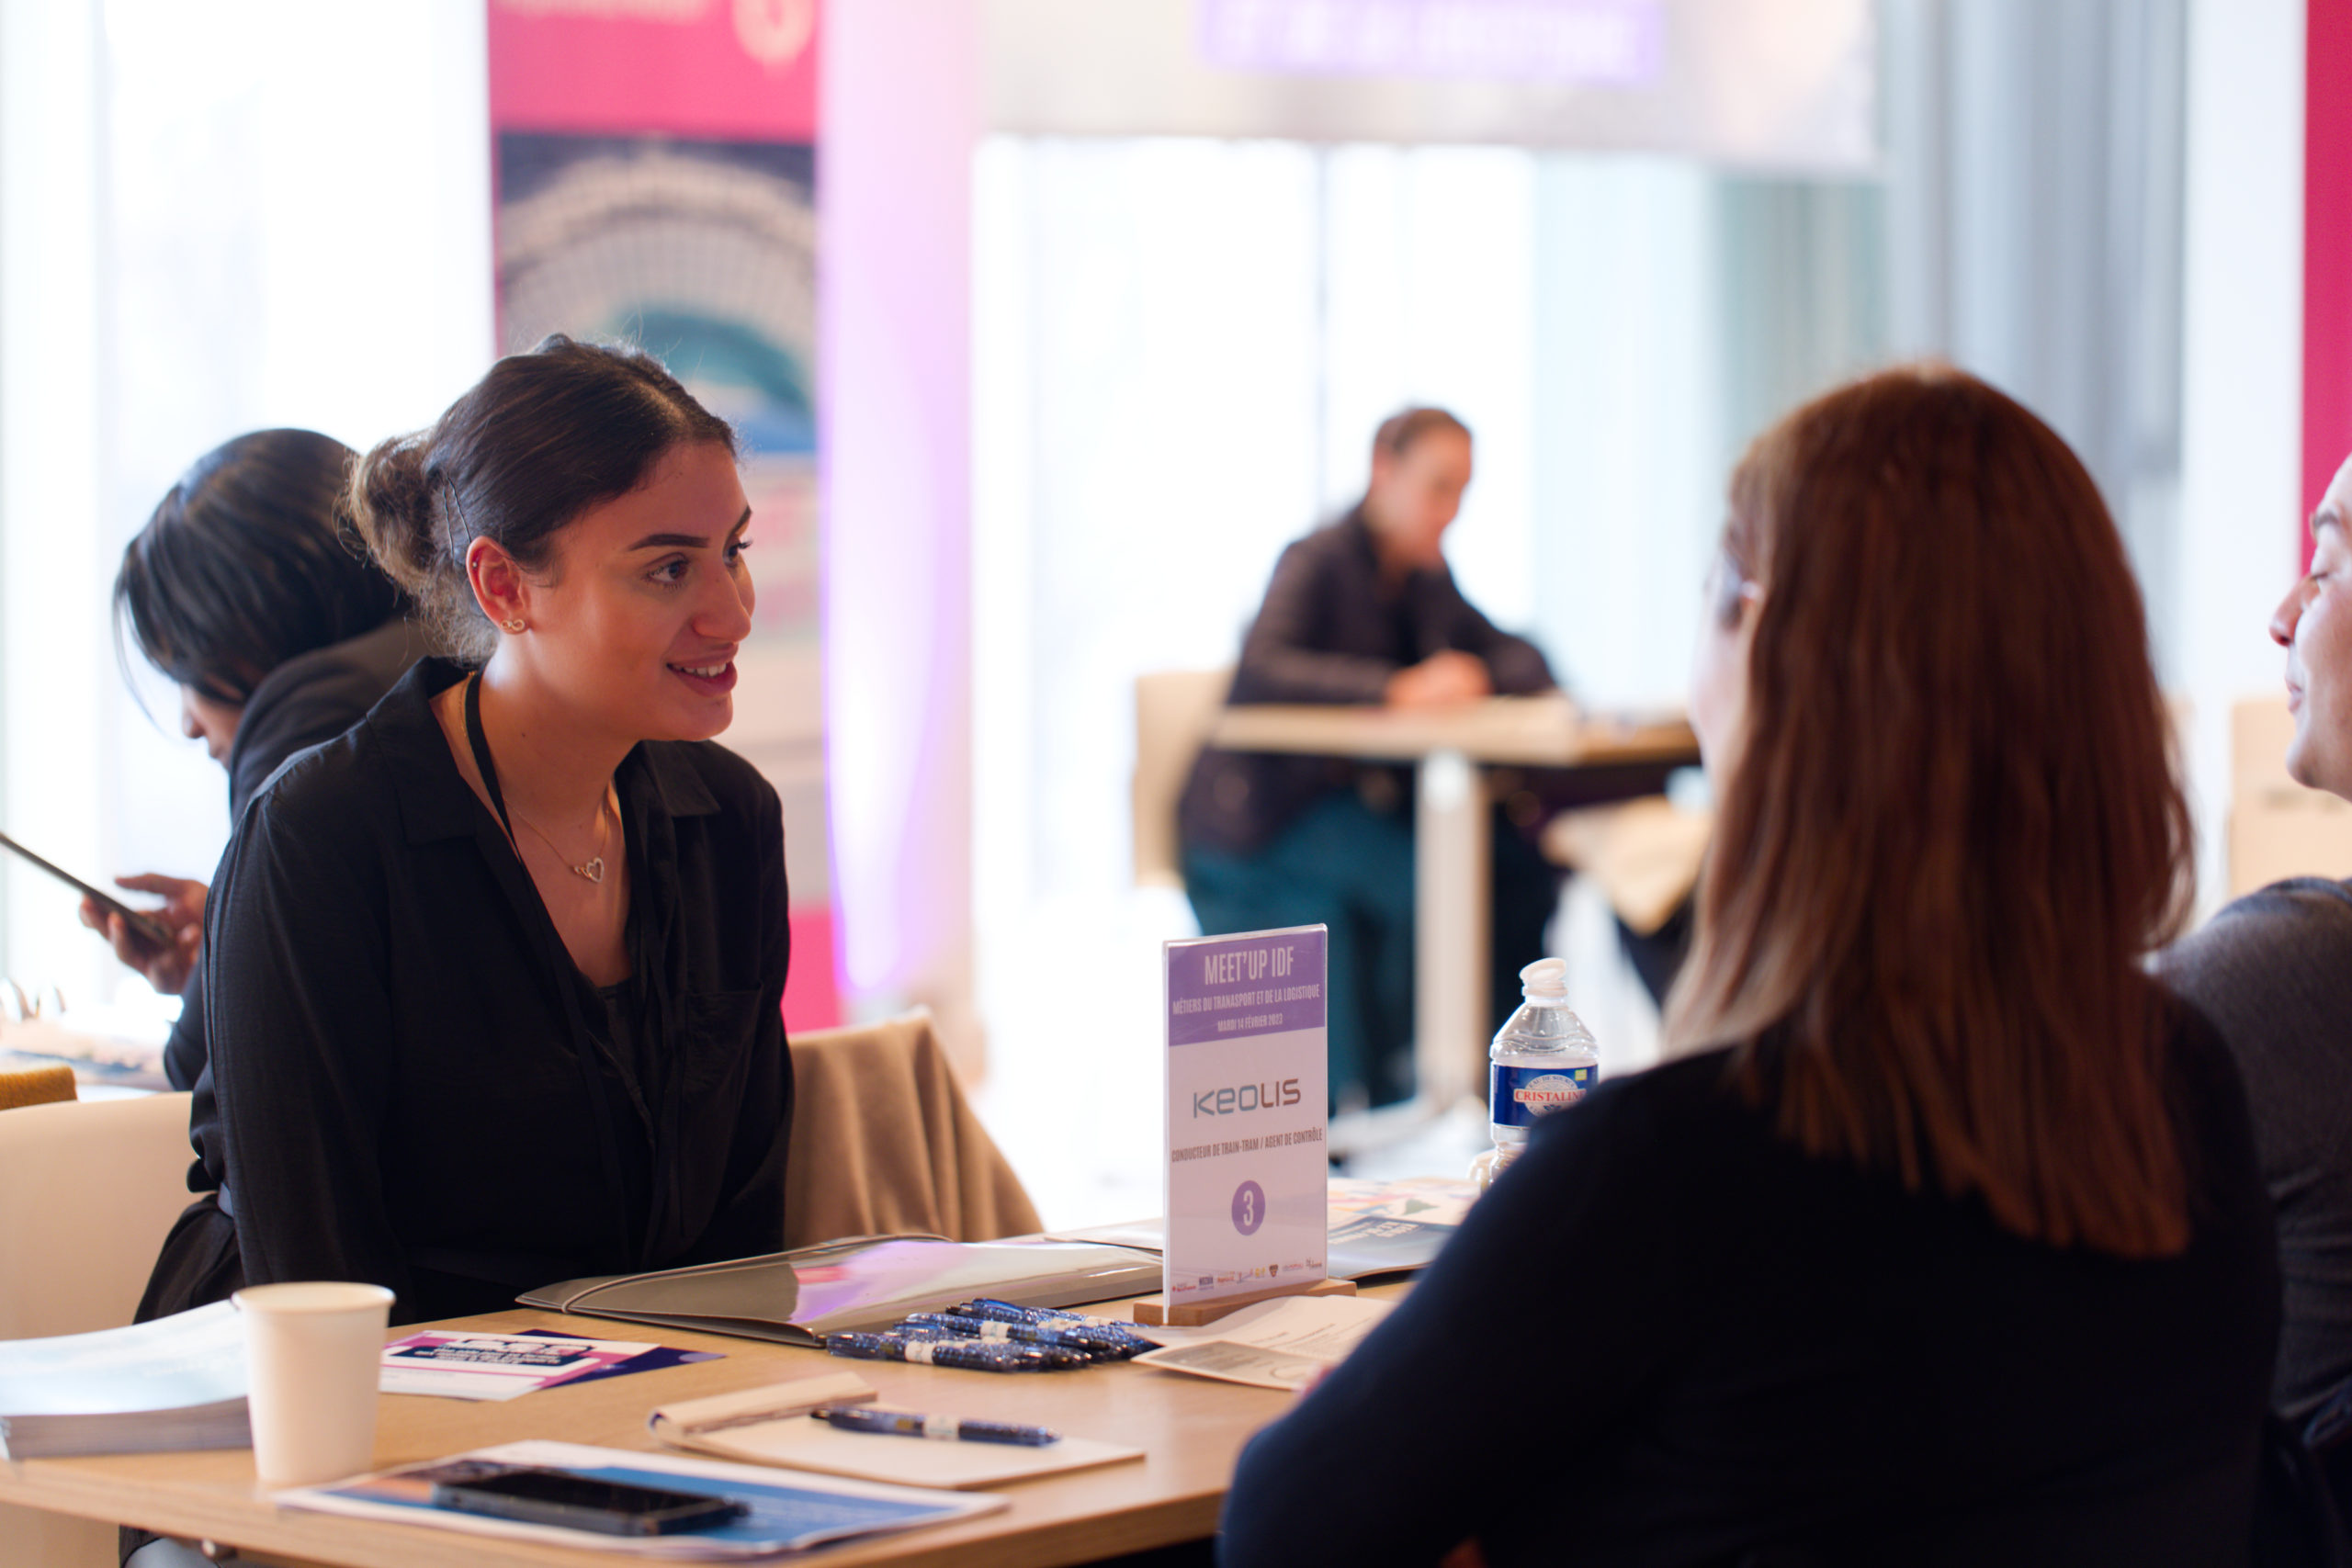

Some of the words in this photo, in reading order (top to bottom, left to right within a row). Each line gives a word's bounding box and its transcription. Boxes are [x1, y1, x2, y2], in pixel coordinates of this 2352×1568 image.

[1205, 950, 1267, 985] MEET'UP
[1272, 946, 1294, 977] IDF
[1172, 997, 1202, 1015] MÉTIERS
[1203, 997, 1213, 1012] DU
[1256, 990, 1264, 1005] ET
[1265, 988, 1273, 1004] DE
[1274, 987, 1283, 1003] LA
[1283, 984, 1320, 1002] LOGISTIQUE
[1217, 1019, 1237, 1032] MARDI
[1238, 1017, 1244, 1030] 14
[1244, 1014, 1268, 1030] FÉVRIER
[1269, 1013, 1283, 1026] 2023
[1171, 1145, 1212, 1163] CONDUCTEUR
[1213, 1144, 1220, 1156] DE
[1221, 1138, 1259, 1155] TRAIN-TRAM
[1264, 1133, 1283, 1149] AGENT
[1284, 1133, 1292, 1146] DE
[1293, 1126, 1323, 1145] CONTRÔLE
[1243, 1190, 1254, 1226] 3
